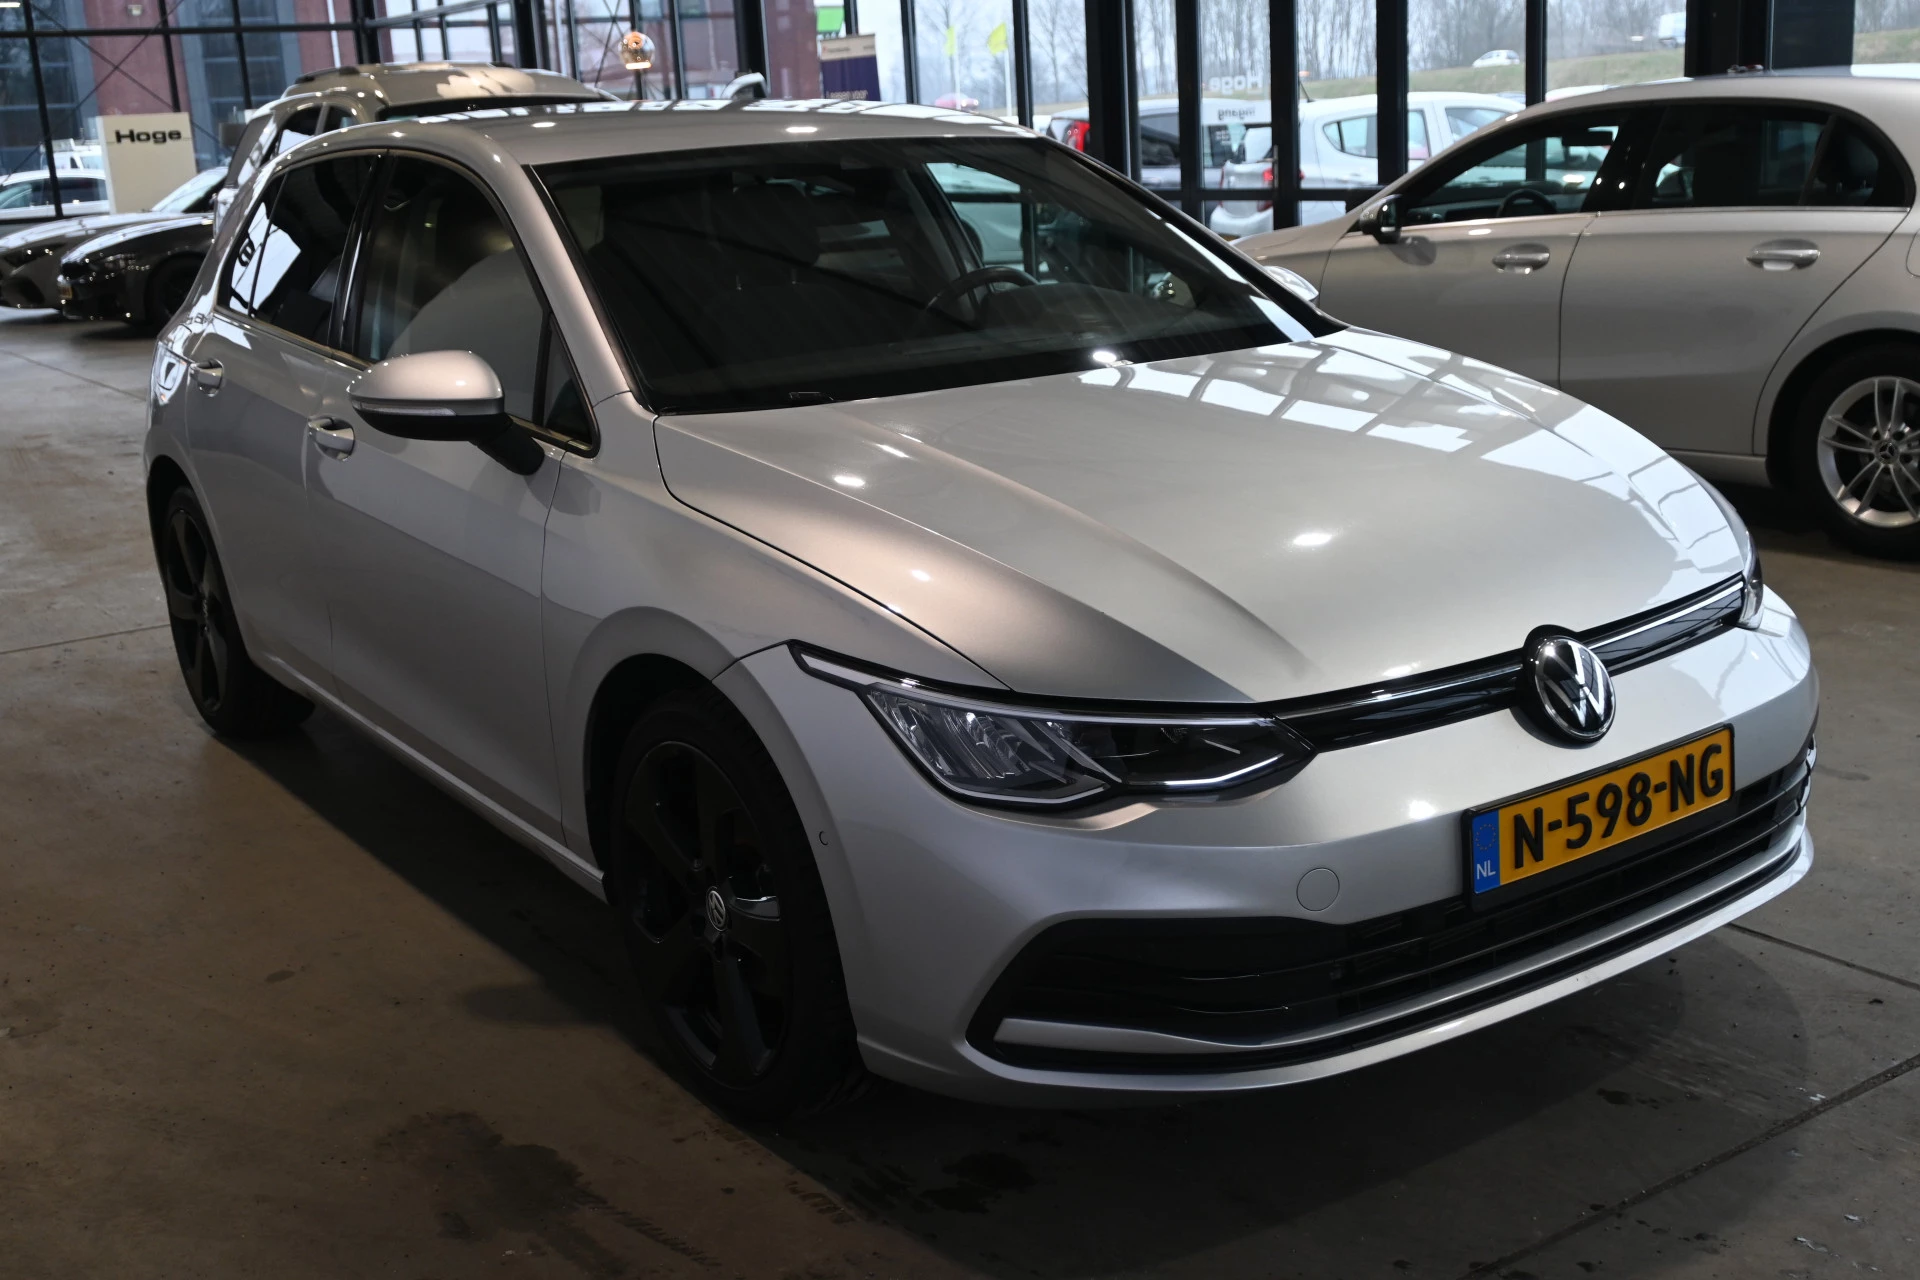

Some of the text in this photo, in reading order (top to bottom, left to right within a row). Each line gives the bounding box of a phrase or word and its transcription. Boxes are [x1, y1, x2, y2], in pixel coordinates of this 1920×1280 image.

[115, 128, 182, 145] Hoge
[1513, 743, 1724, 870] N-598-NG
[1476, 860, 1496, 880] NL
